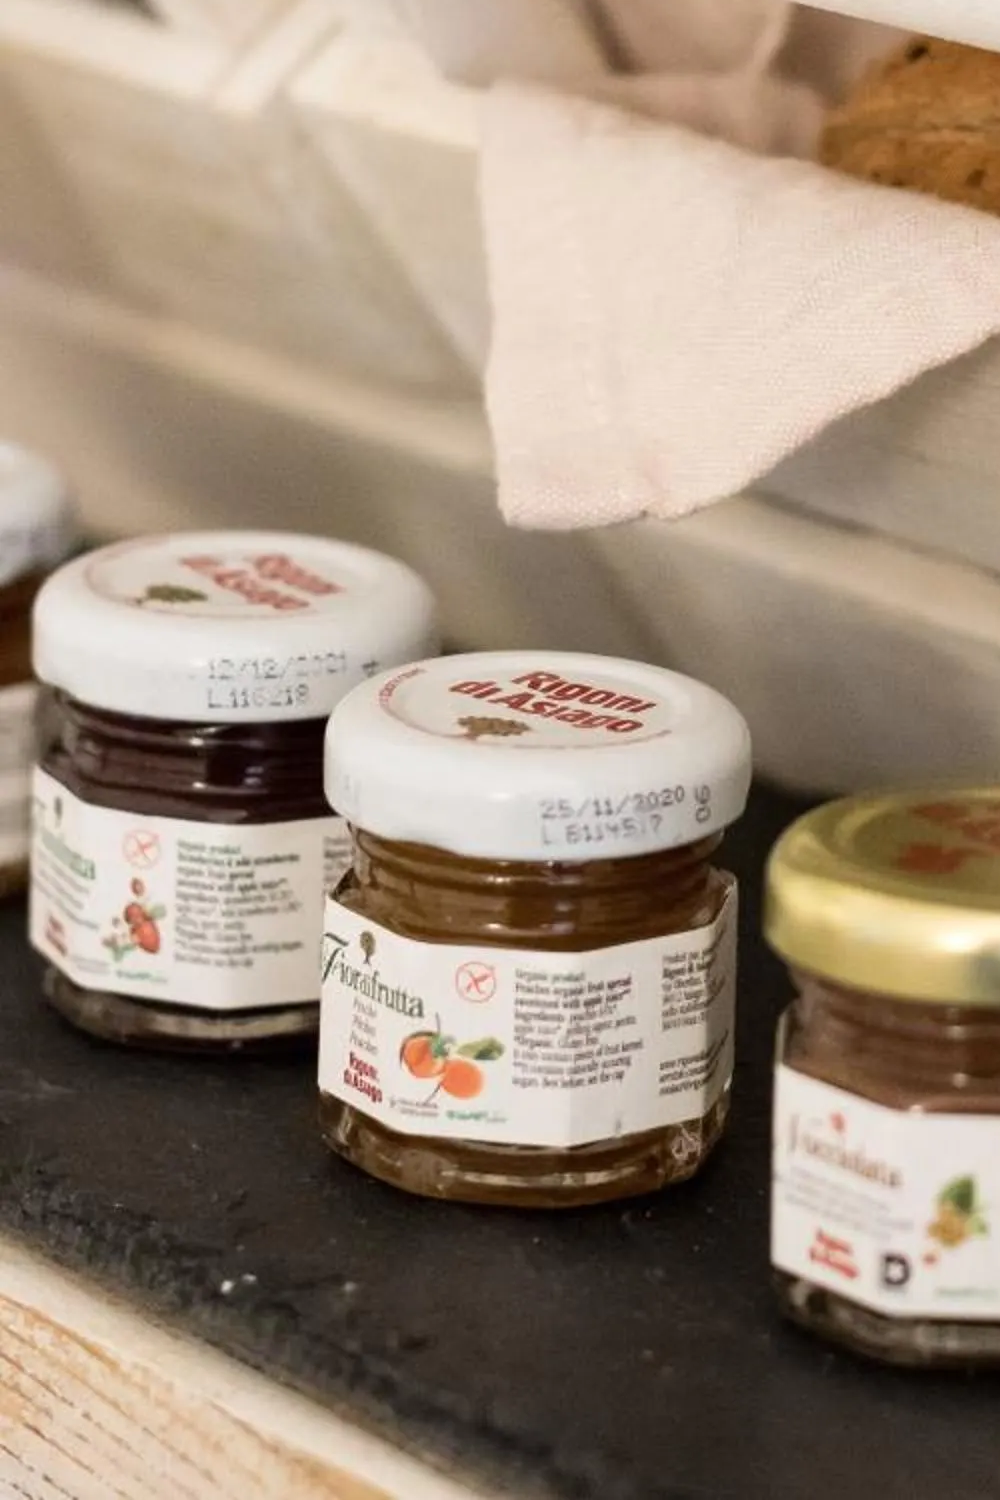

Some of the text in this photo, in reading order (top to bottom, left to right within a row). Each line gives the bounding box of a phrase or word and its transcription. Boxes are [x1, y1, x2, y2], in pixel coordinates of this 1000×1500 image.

[449, 680, 503, 699] di
[488, 692, 645, 734] Asiago
[511, 671, 658, 713] Rigoni
[538, 784, 686, 820] 25/11/2020
